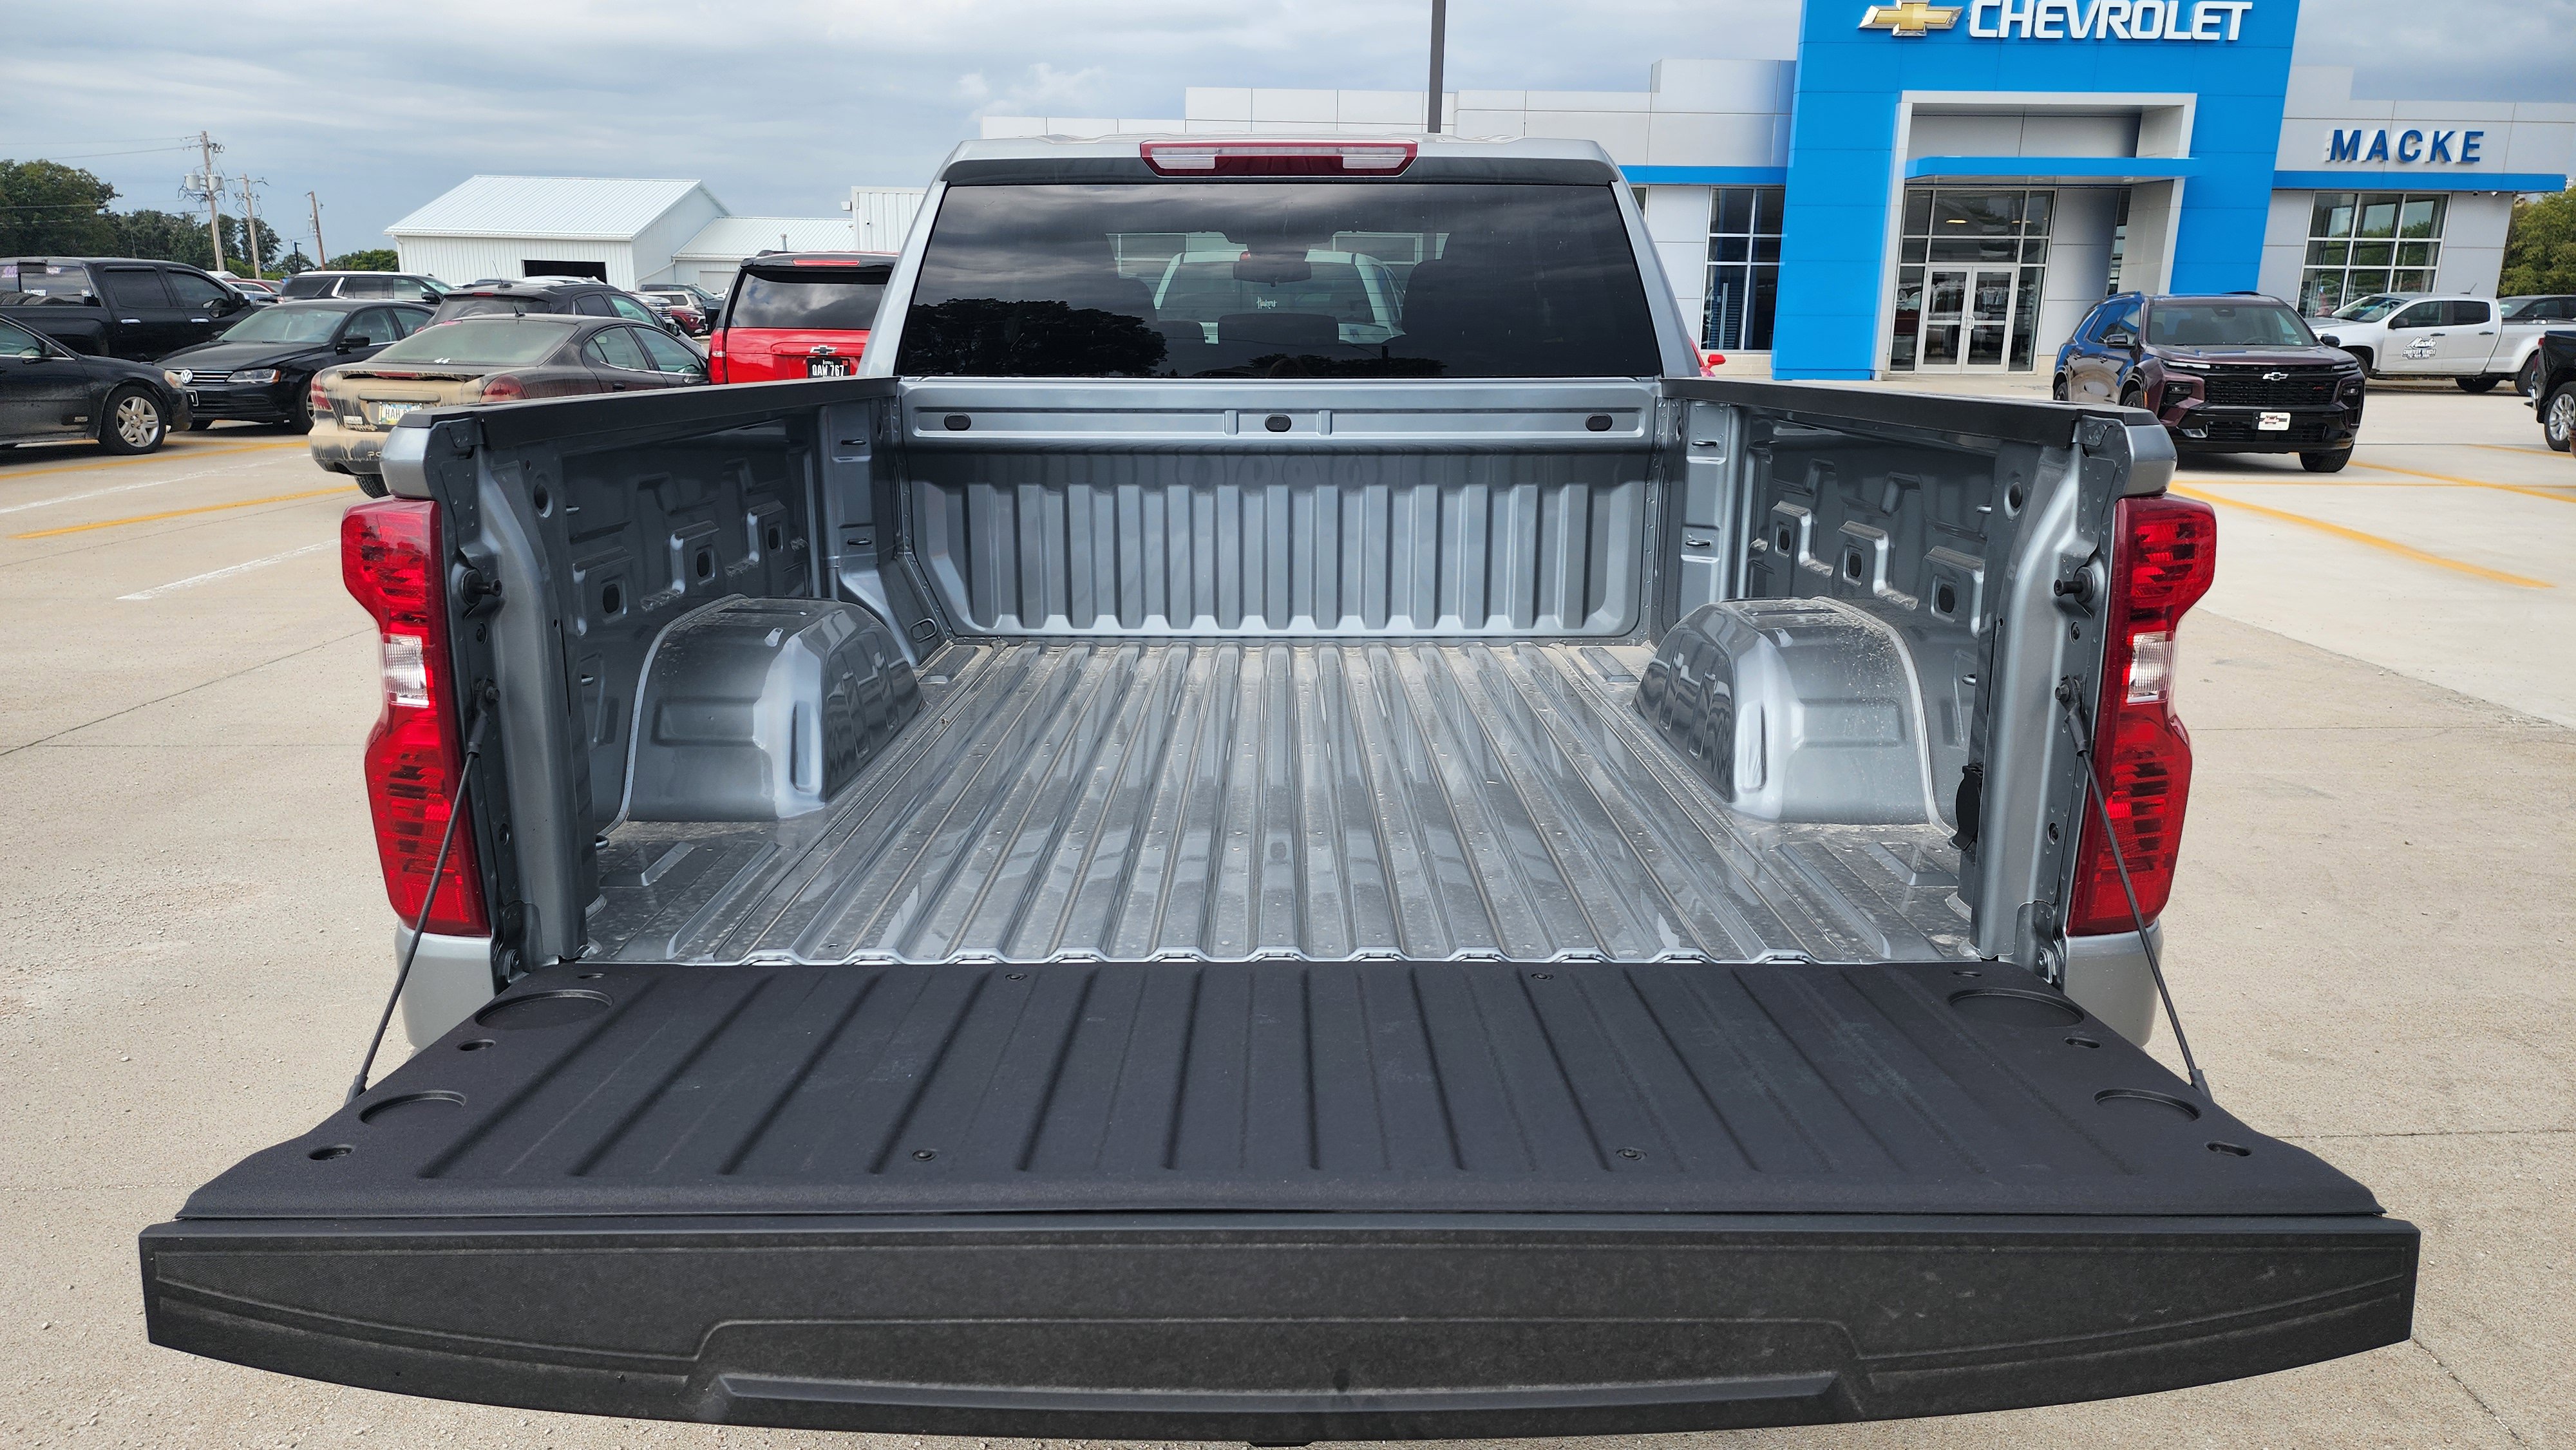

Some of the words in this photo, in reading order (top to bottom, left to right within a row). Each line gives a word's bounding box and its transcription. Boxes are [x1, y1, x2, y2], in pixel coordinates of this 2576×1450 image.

[1968, 0, 2253, 41] CHEVROLET
[2327, 129, 2484, 162] MACKE
[812, 364, 828, 376] QAW
[830, 364, 844, 377] 767
